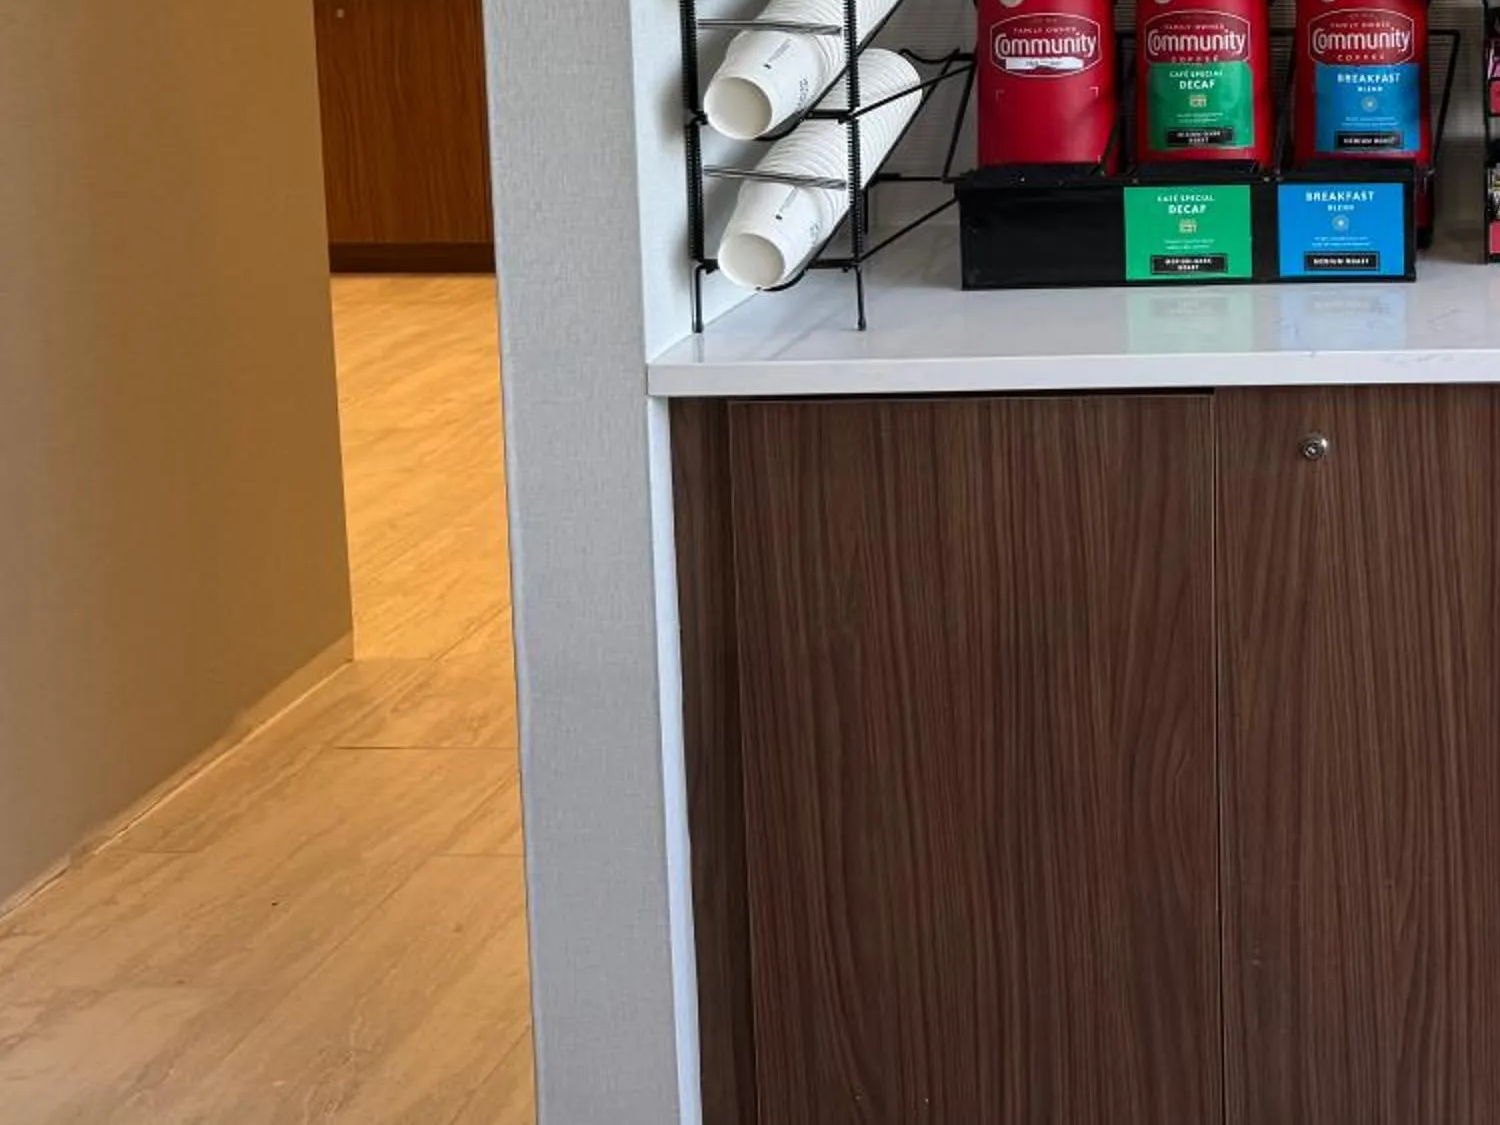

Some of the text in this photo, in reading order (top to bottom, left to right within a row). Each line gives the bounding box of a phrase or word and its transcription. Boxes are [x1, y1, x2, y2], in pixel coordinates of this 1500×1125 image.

[995, 32, 1097, 60] Community
[1147, 28, 1246, 56] Community
[1312, 27, 1411, 54] Community
[1179, 79, 1216, 90] DECAF
[1337, 73, 1401, 84] BREAKFAST
[1305, 190, 1376, 202] BREAKFAST
[1168, 204, 1207, 214] DECAF
